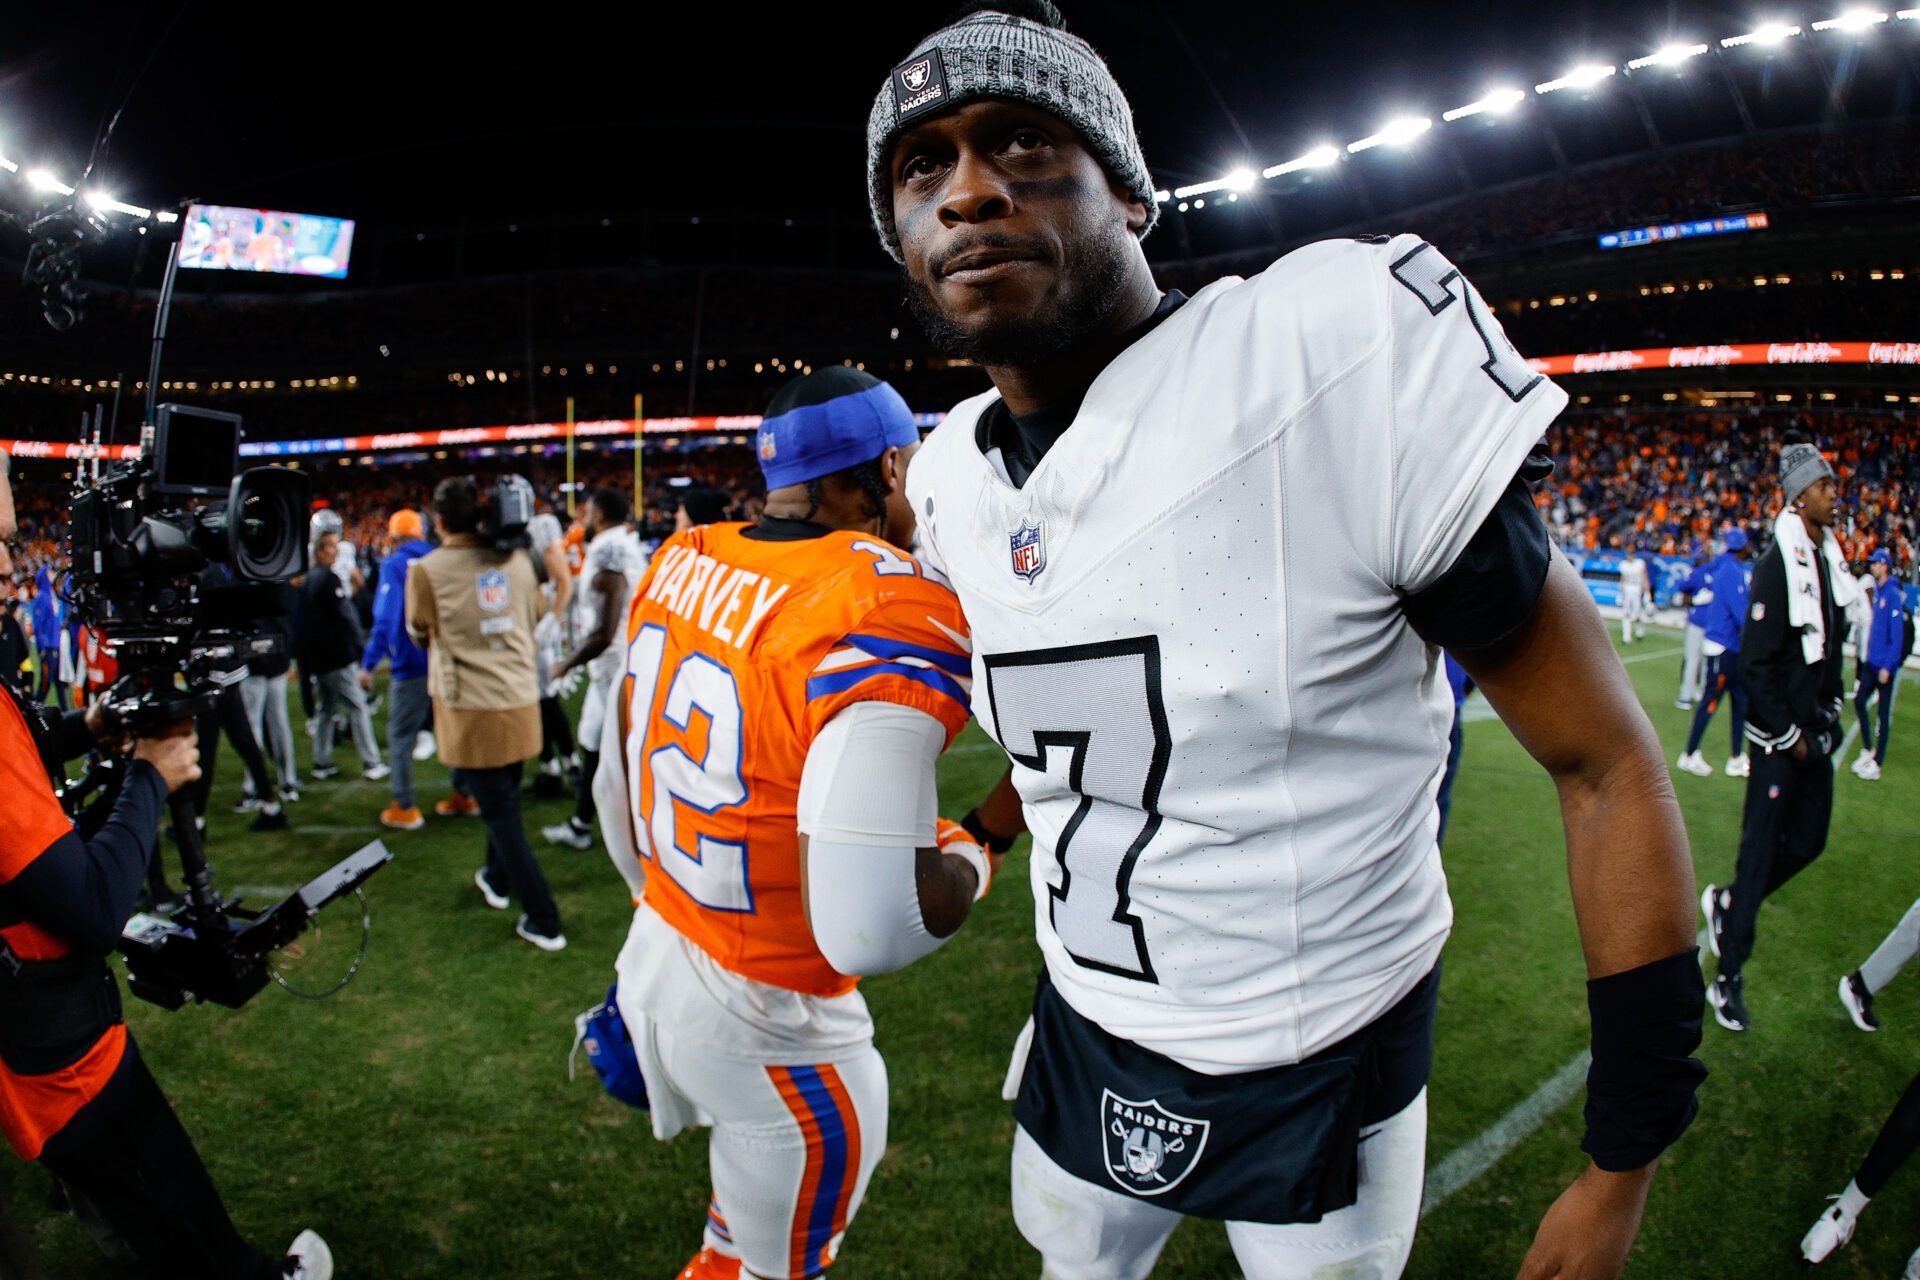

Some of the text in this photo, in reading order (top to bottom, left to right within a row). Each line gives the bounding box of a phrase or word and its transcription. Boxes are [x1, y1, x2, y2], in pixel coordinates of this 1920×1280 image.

[900, 88, 942, 113] RAIDERS
[917, 83, 941, 97] VEGAS
[1388, 241, 1545, 403] 7
[1014, 545, 1039, 572] NFL
[647, 544, 791, 650] HARVEY
[626, 621, 757, 915] 12
[982, 634, 1172, 985] 7
[1112, 1101, 1194, 1136] RAIDERS
